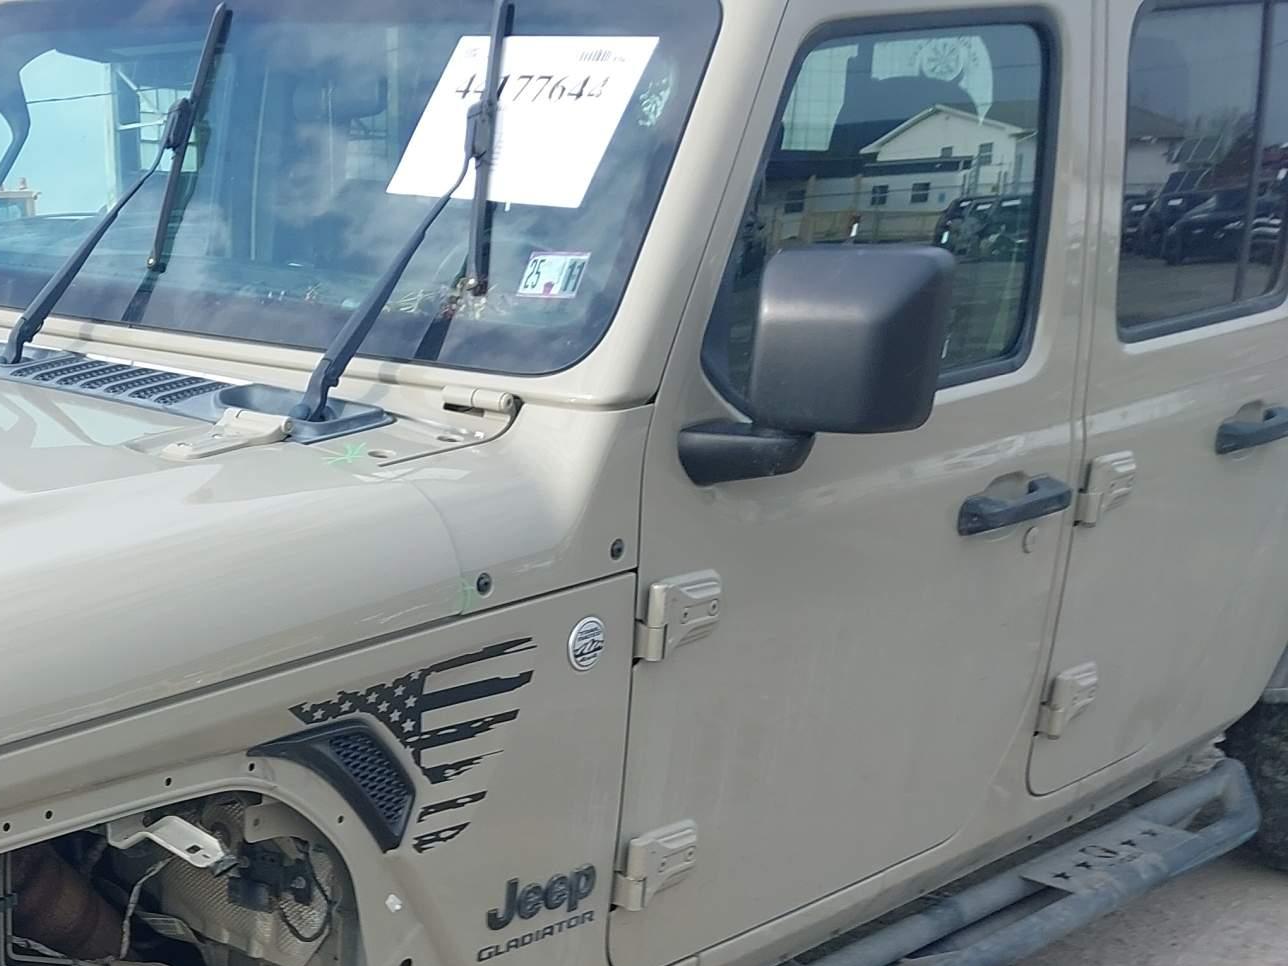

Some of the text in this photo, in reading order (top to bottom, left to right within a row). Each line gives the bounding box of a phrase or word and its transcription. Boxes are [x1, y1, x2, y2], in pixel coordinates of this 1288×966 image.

[523, 259, 546, 288] 25
[487, 863, 596, 931] Jeep
[477, 910, 594, 962] GLADIATOR
